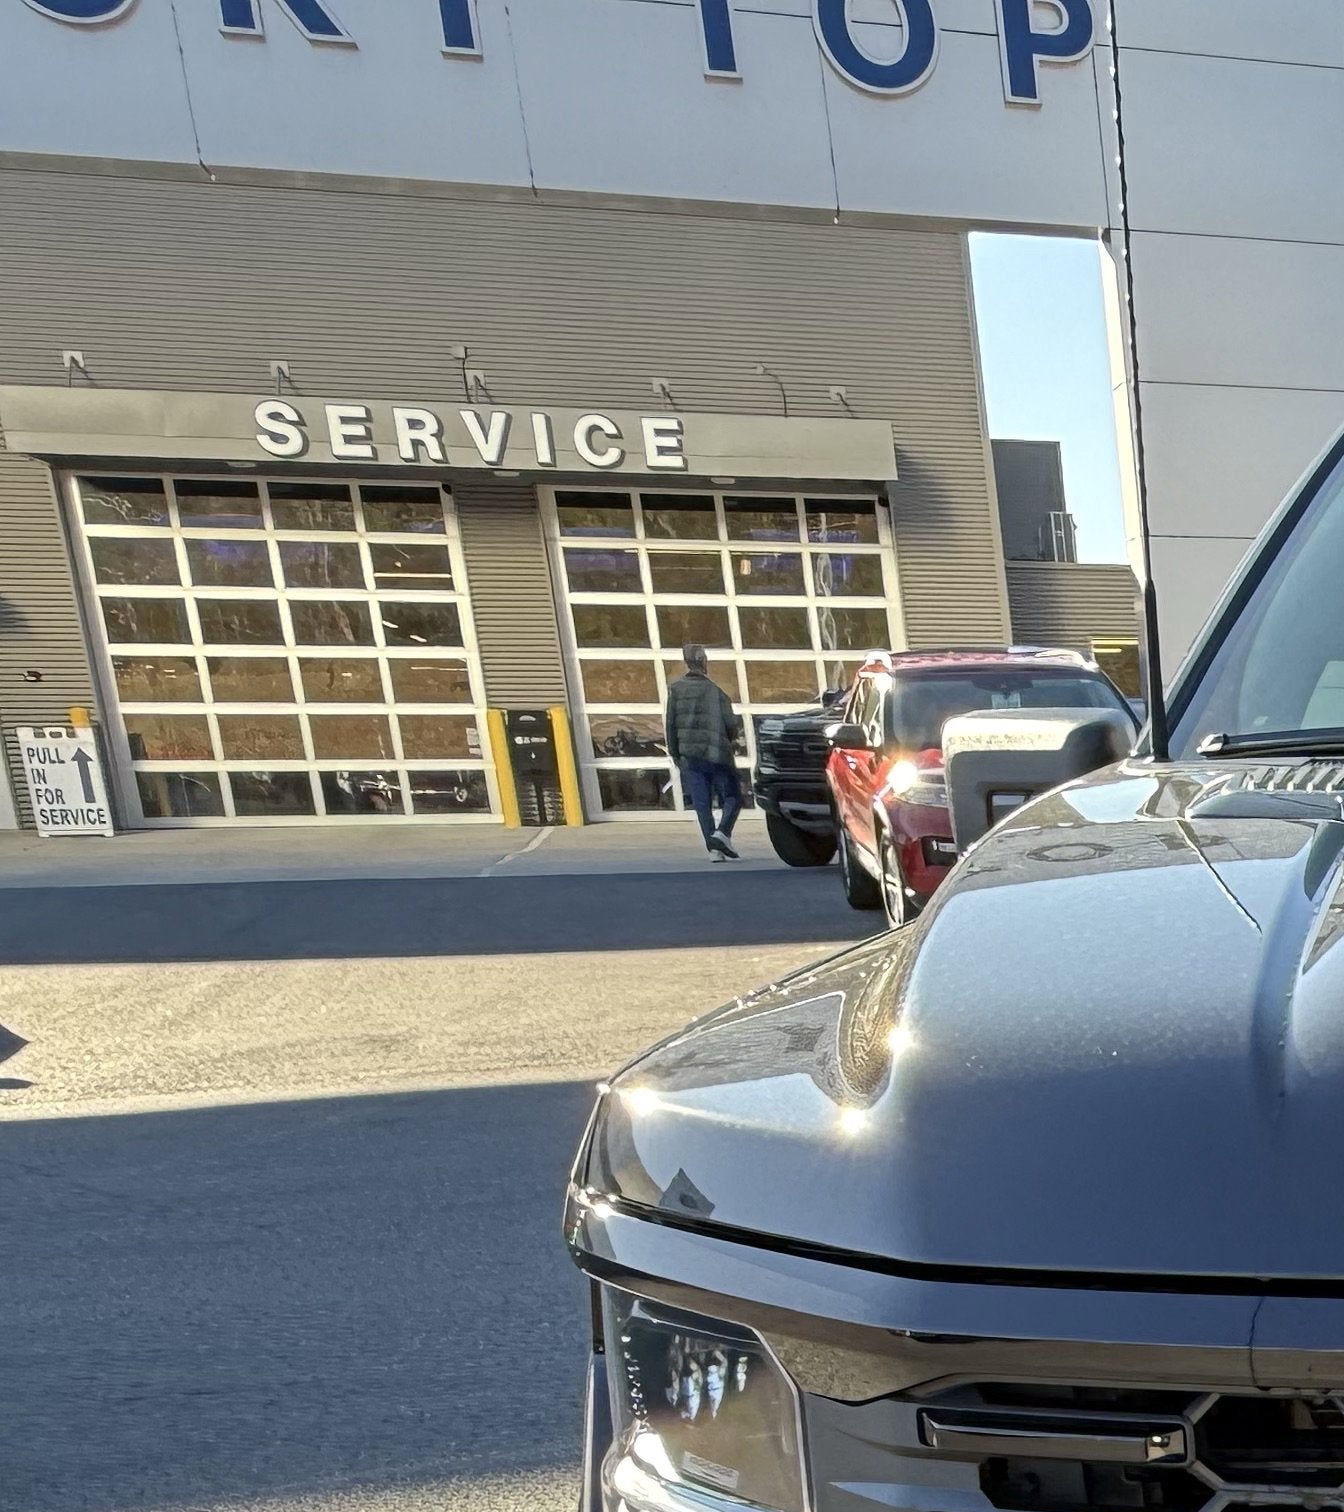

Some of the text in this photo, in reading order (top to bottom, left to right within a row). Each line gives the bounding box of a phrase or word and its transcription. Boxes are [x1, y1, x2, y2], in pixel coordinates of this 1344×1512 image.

[253, 399, 688, 471] SERVICE
[26, 746, 66, 765] PULL
[31, 767, 48, 785] IN
[35, 787, 66, 805] FOR
[39, 807, 107, 826] SERVICE
